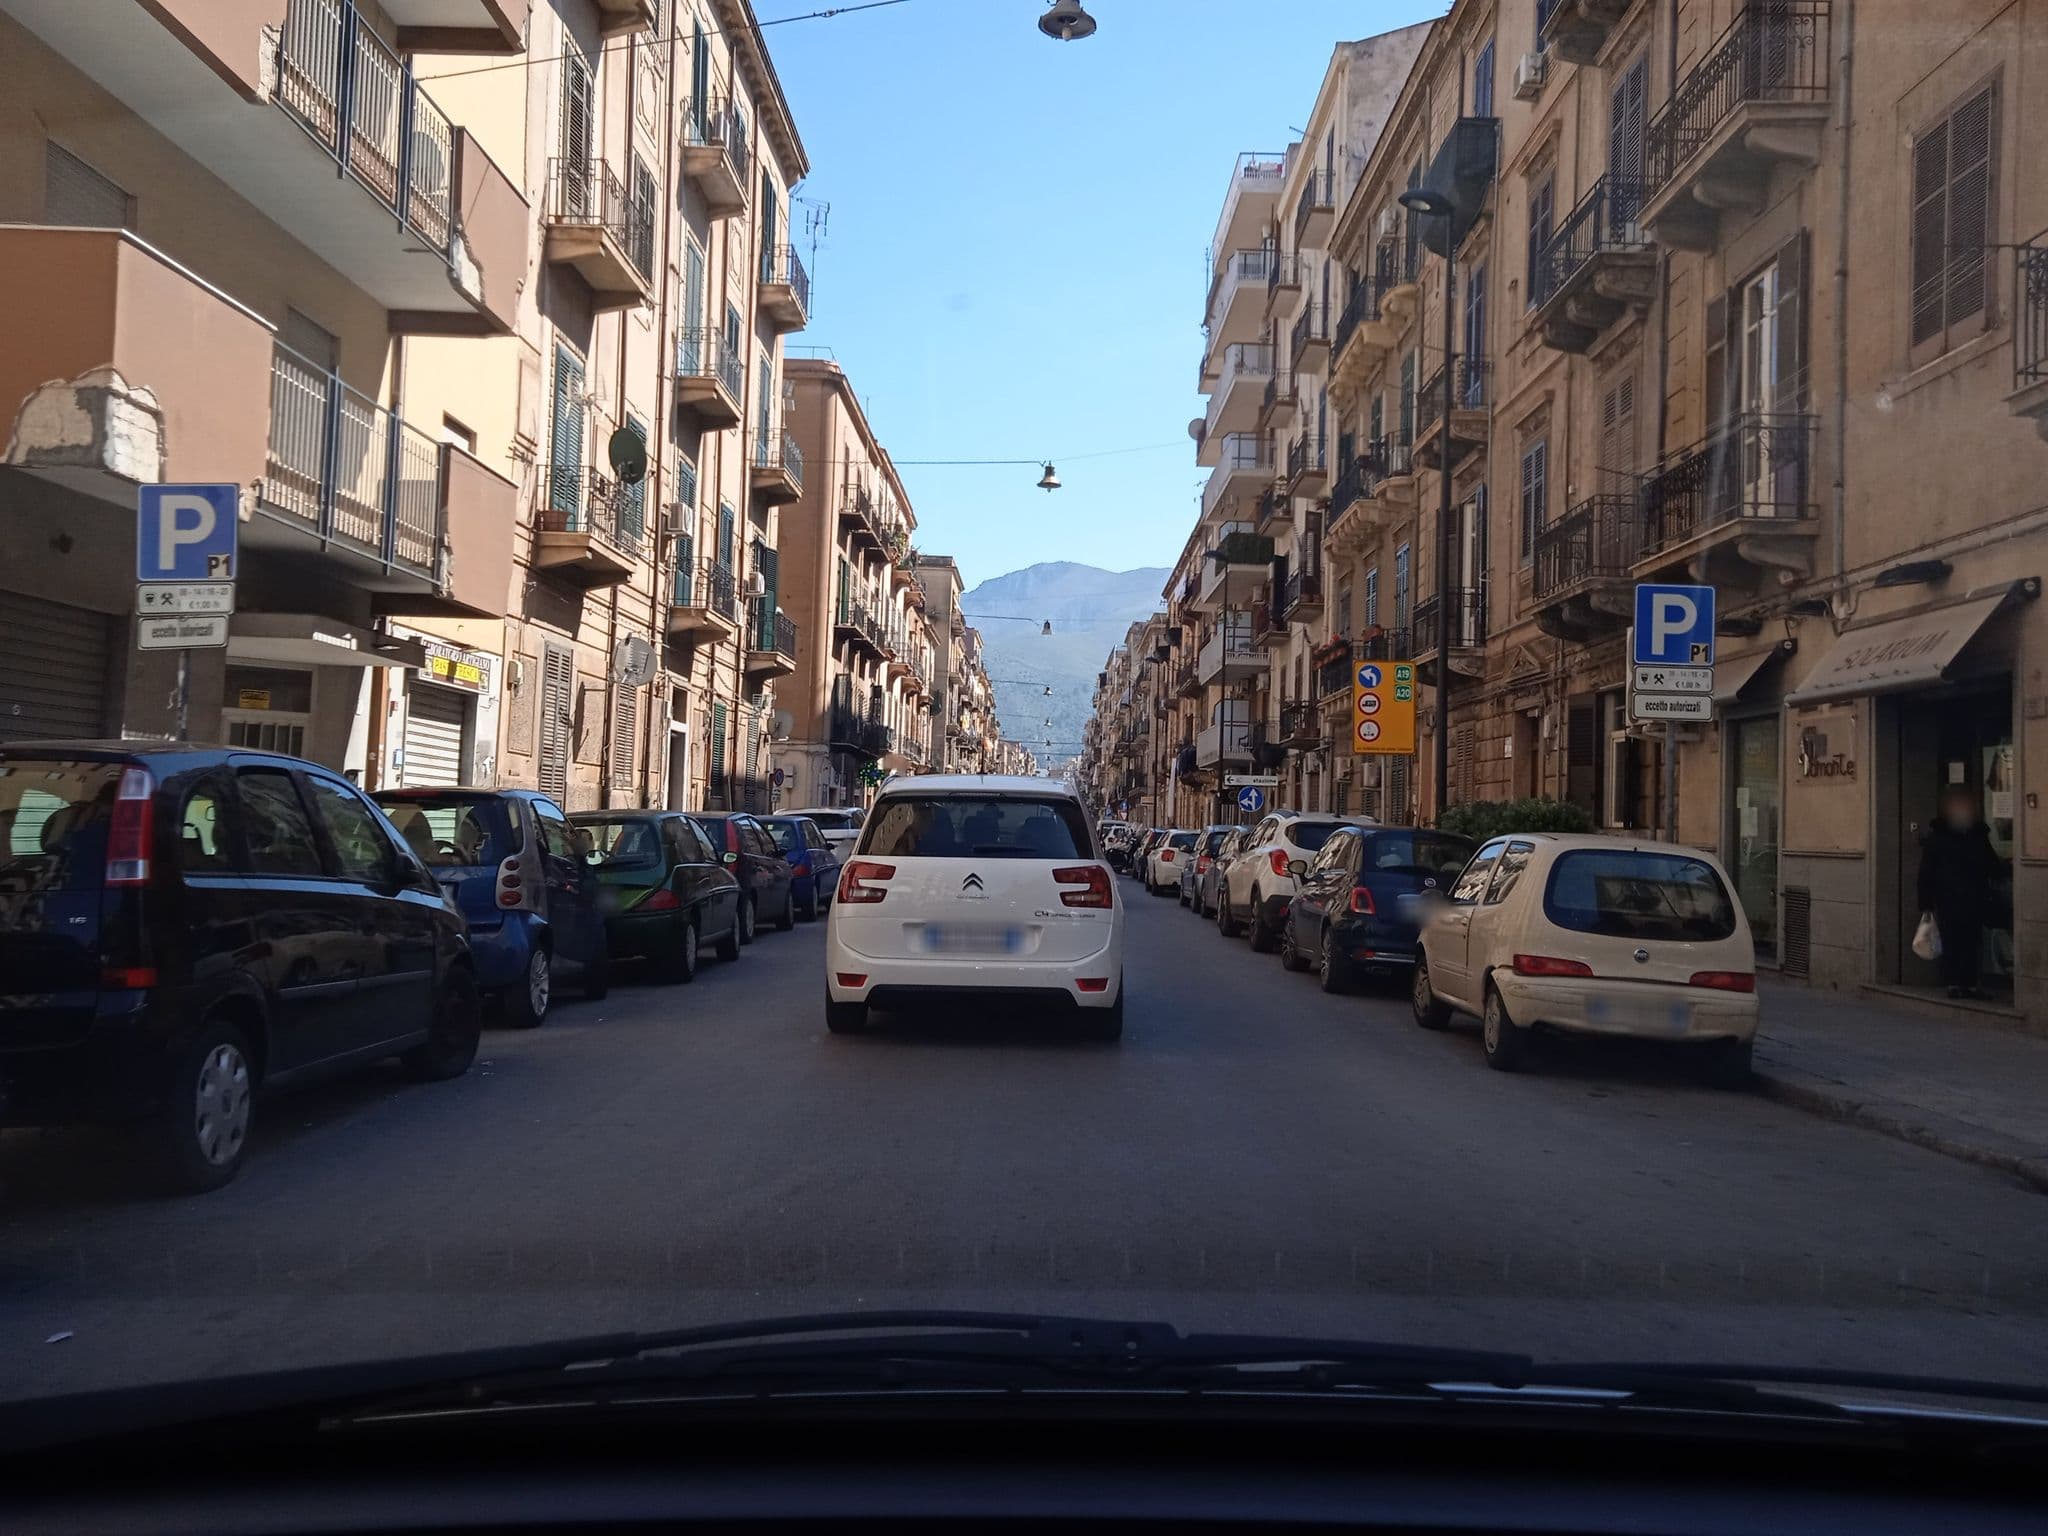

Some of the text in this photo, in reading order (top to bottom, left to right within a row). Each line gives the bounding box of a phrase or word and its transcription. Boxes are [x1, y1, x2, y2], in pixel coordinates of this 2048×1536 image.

[158, 494, 216, 570] P
[209, 555, 231, 577] P1
[1651, 593, 1697, 655] P
[1691, 645, 1709, 661] P1
[1397, 670, 1410, 679] A19
[1396, 688, 1411, 698] A20
[1645, 702, 1701, 713] eccetto autorizzati
[1034, 910, 1049, 918] C4
